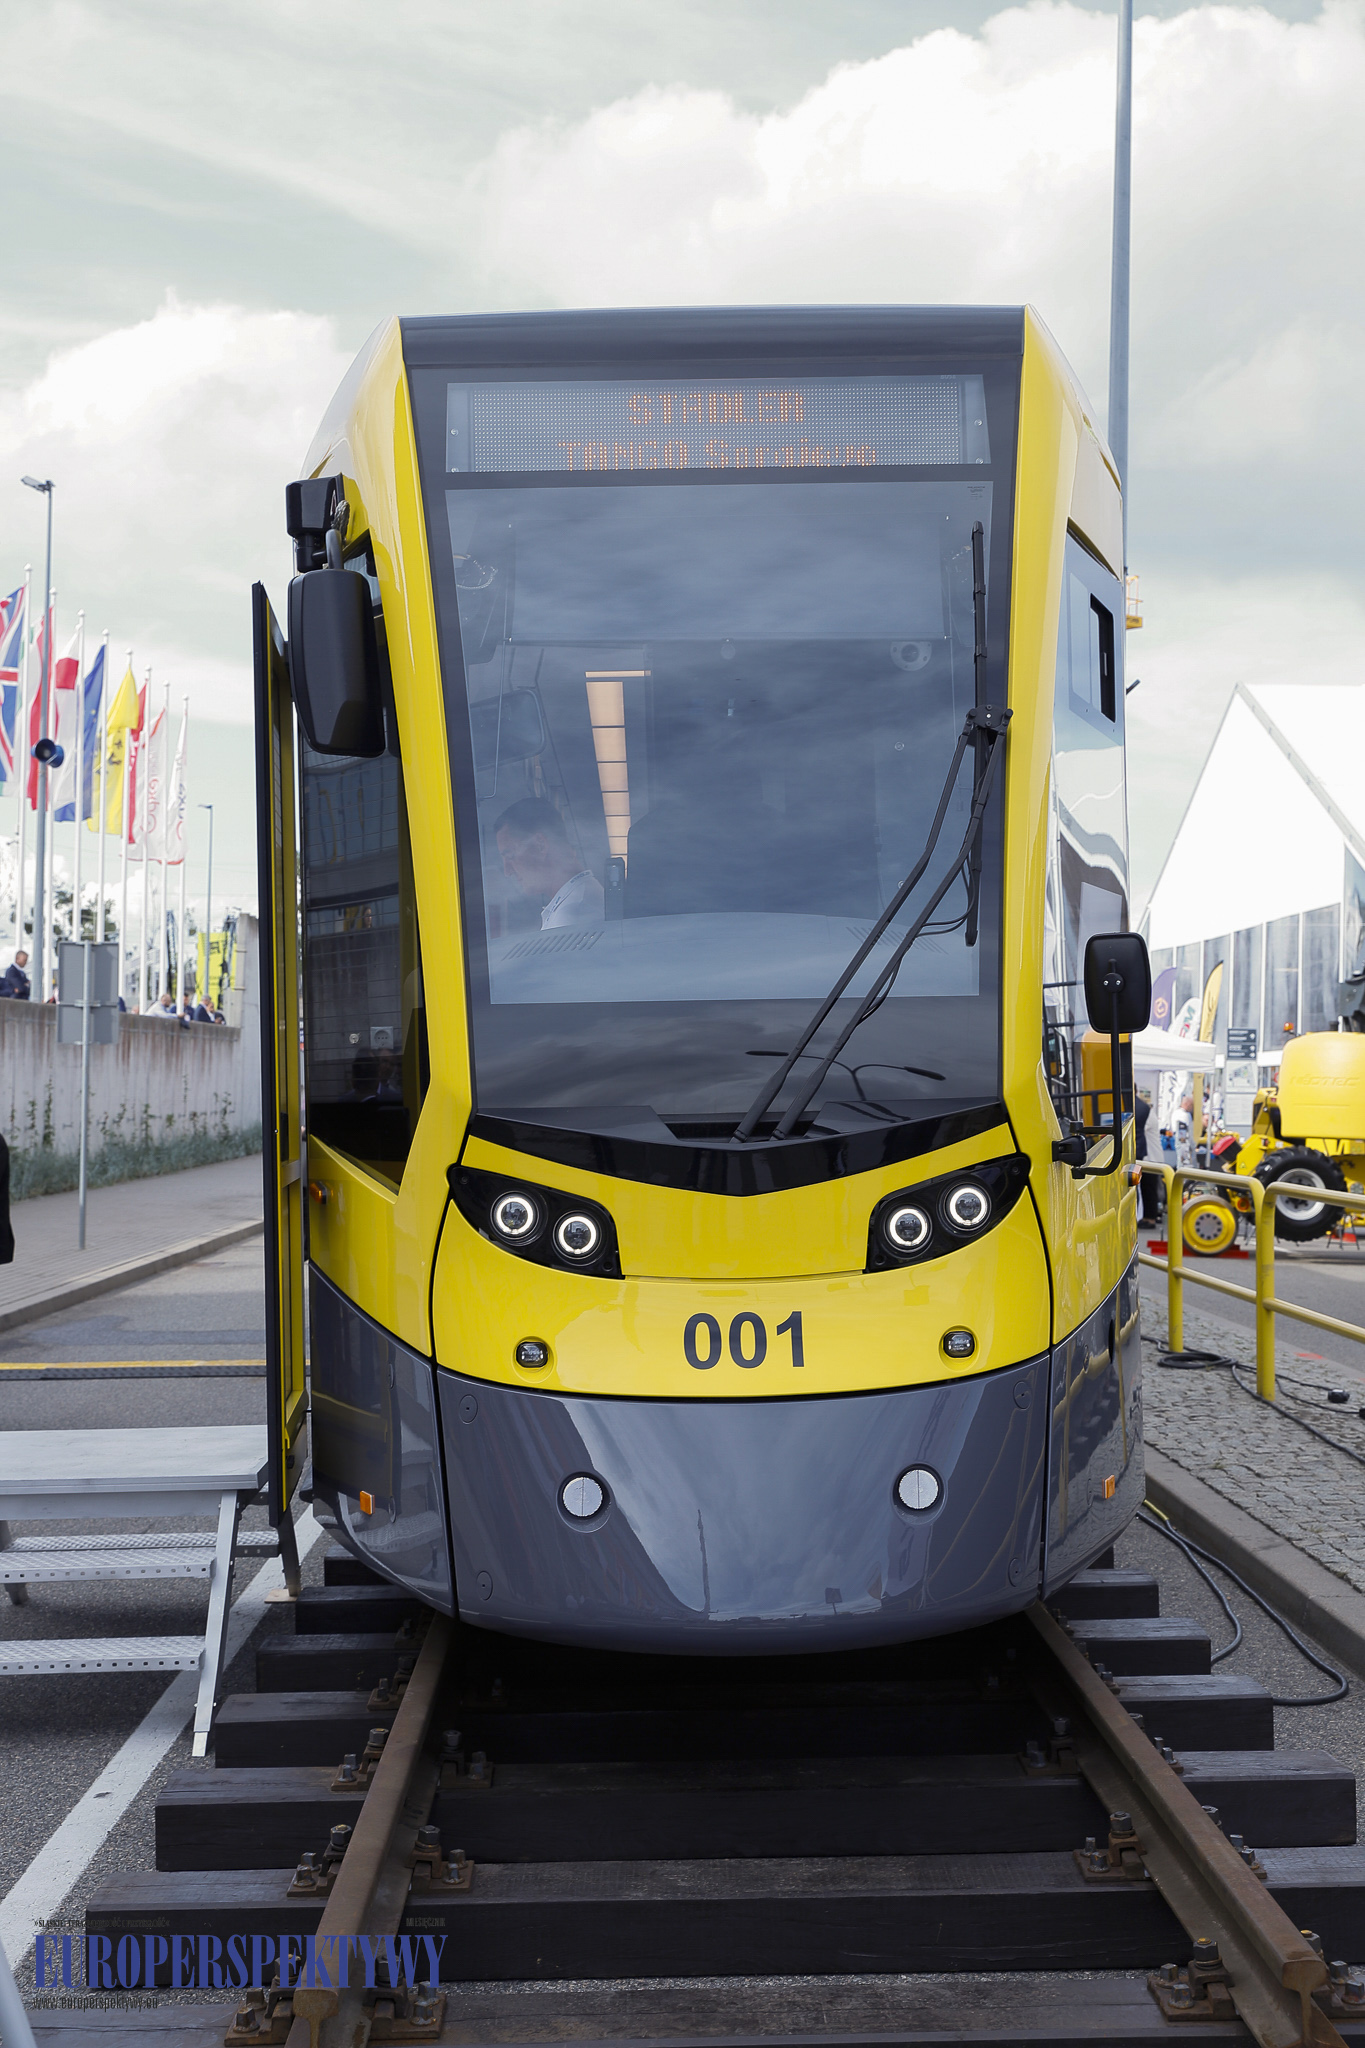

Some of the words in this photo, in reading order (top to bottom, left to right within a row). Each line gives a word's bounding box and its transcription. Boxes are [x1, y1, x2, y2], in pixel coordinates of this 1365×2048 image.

[628, 390, 804, 424] STADLER
[556, 439, 688, 471] TANGO
[683, 1310, 805, 1370] 001
